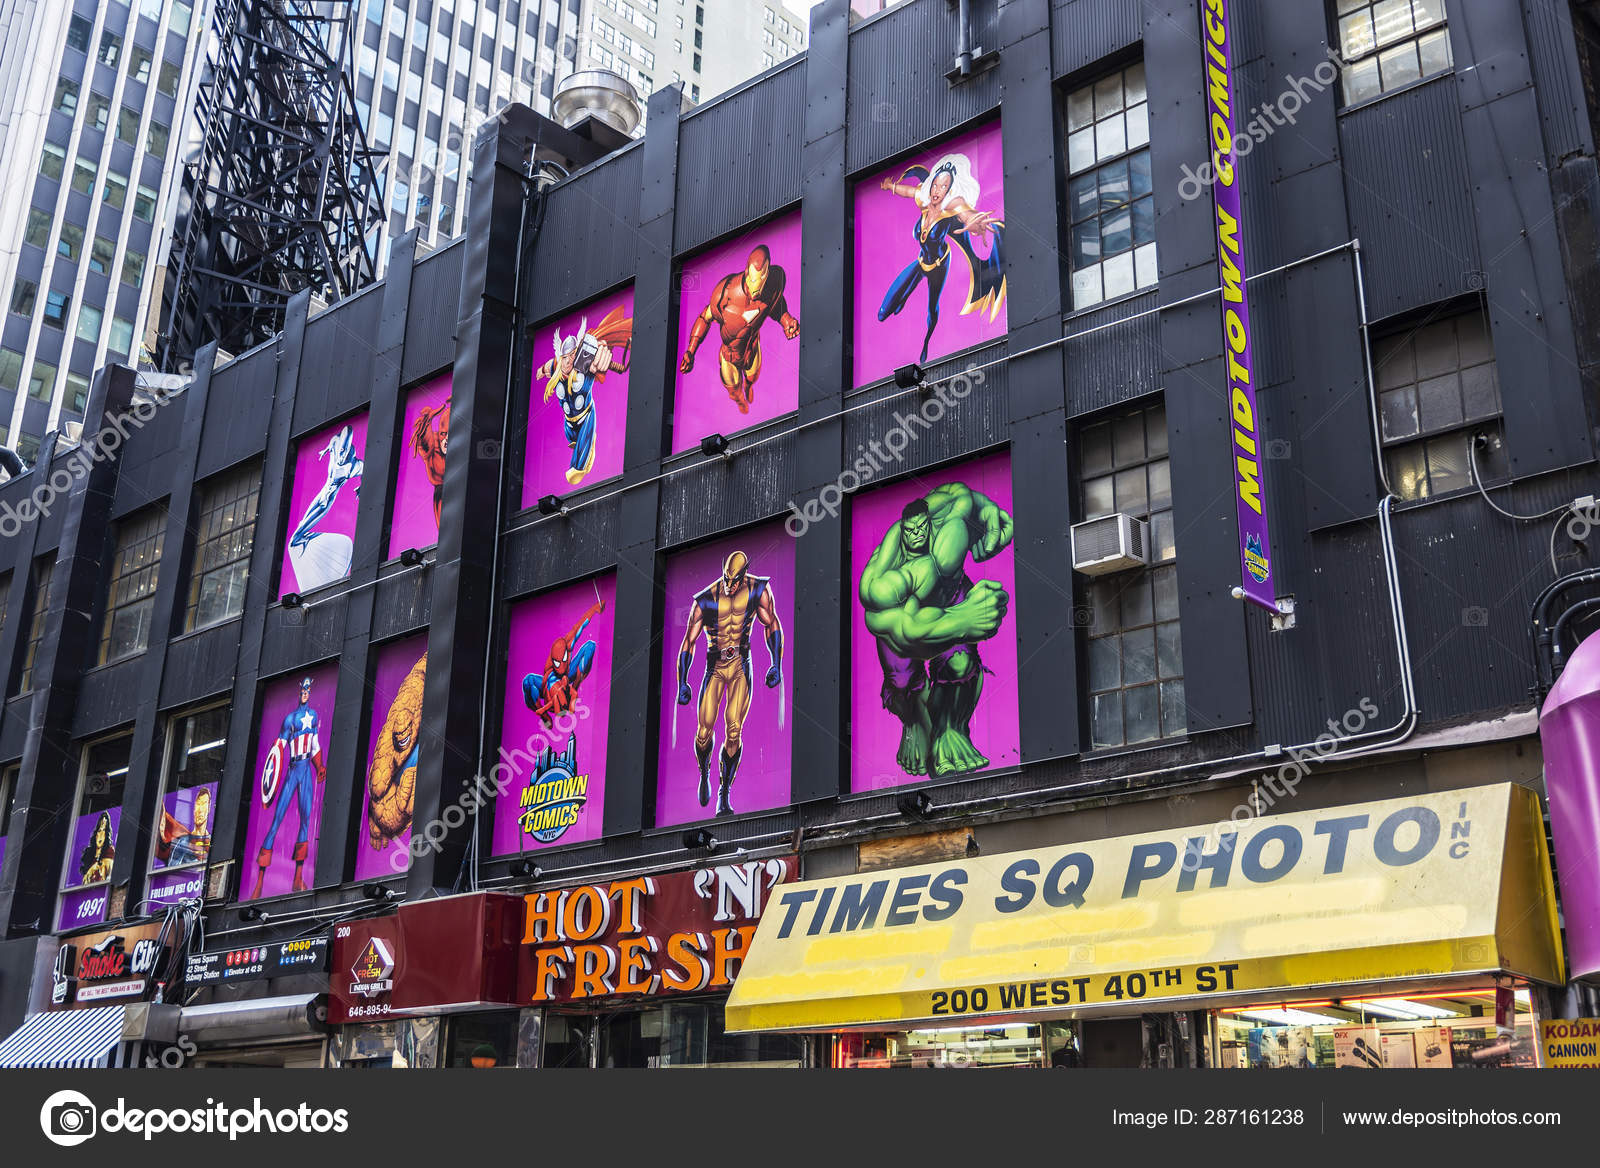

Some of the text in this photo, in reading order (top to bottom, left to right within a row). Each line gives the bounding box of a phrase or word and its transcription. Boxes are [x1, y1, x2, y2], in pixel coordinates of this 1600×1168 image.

[1217, 203, 1262, 515] MIDTOWN
[520, 774, 589, 808] MIDTOWN
[524, 803, 580, 833] COMICS
[542, 830, 556, 840] NYC
[1449, 801, 1471, 859] INC
[777, 806, 1441, 939] TIMES SQ PHOTO
[150, 883, 186, 899] FOLLOW US!
[77, 896, 105, 919] 1997
[521, 877, 655, 944] HOT
[337, 926, 350, 938] 200
[79, 946, 125, 980] Smoke
[188, 955, 218, 965] Times Square
[364, 954, 378, 964] HOT
[532, 925, 757, 1001] FRESH
[186, 964, 208, 973] 42 Street
[186, 971, 219, 982] Subway Station
[229, 968, 244, 976] Elevator
[357, 967, 381, 978] FRESH
[932, 988, 988, 1014] 200
[999, 977, 1090, 1009] WEST
[1196, 964, 1239, 992] ST
[1545, 1024, 1600, 1039] KODAK
[1549, 1044, 1597, 1058] CANNON
